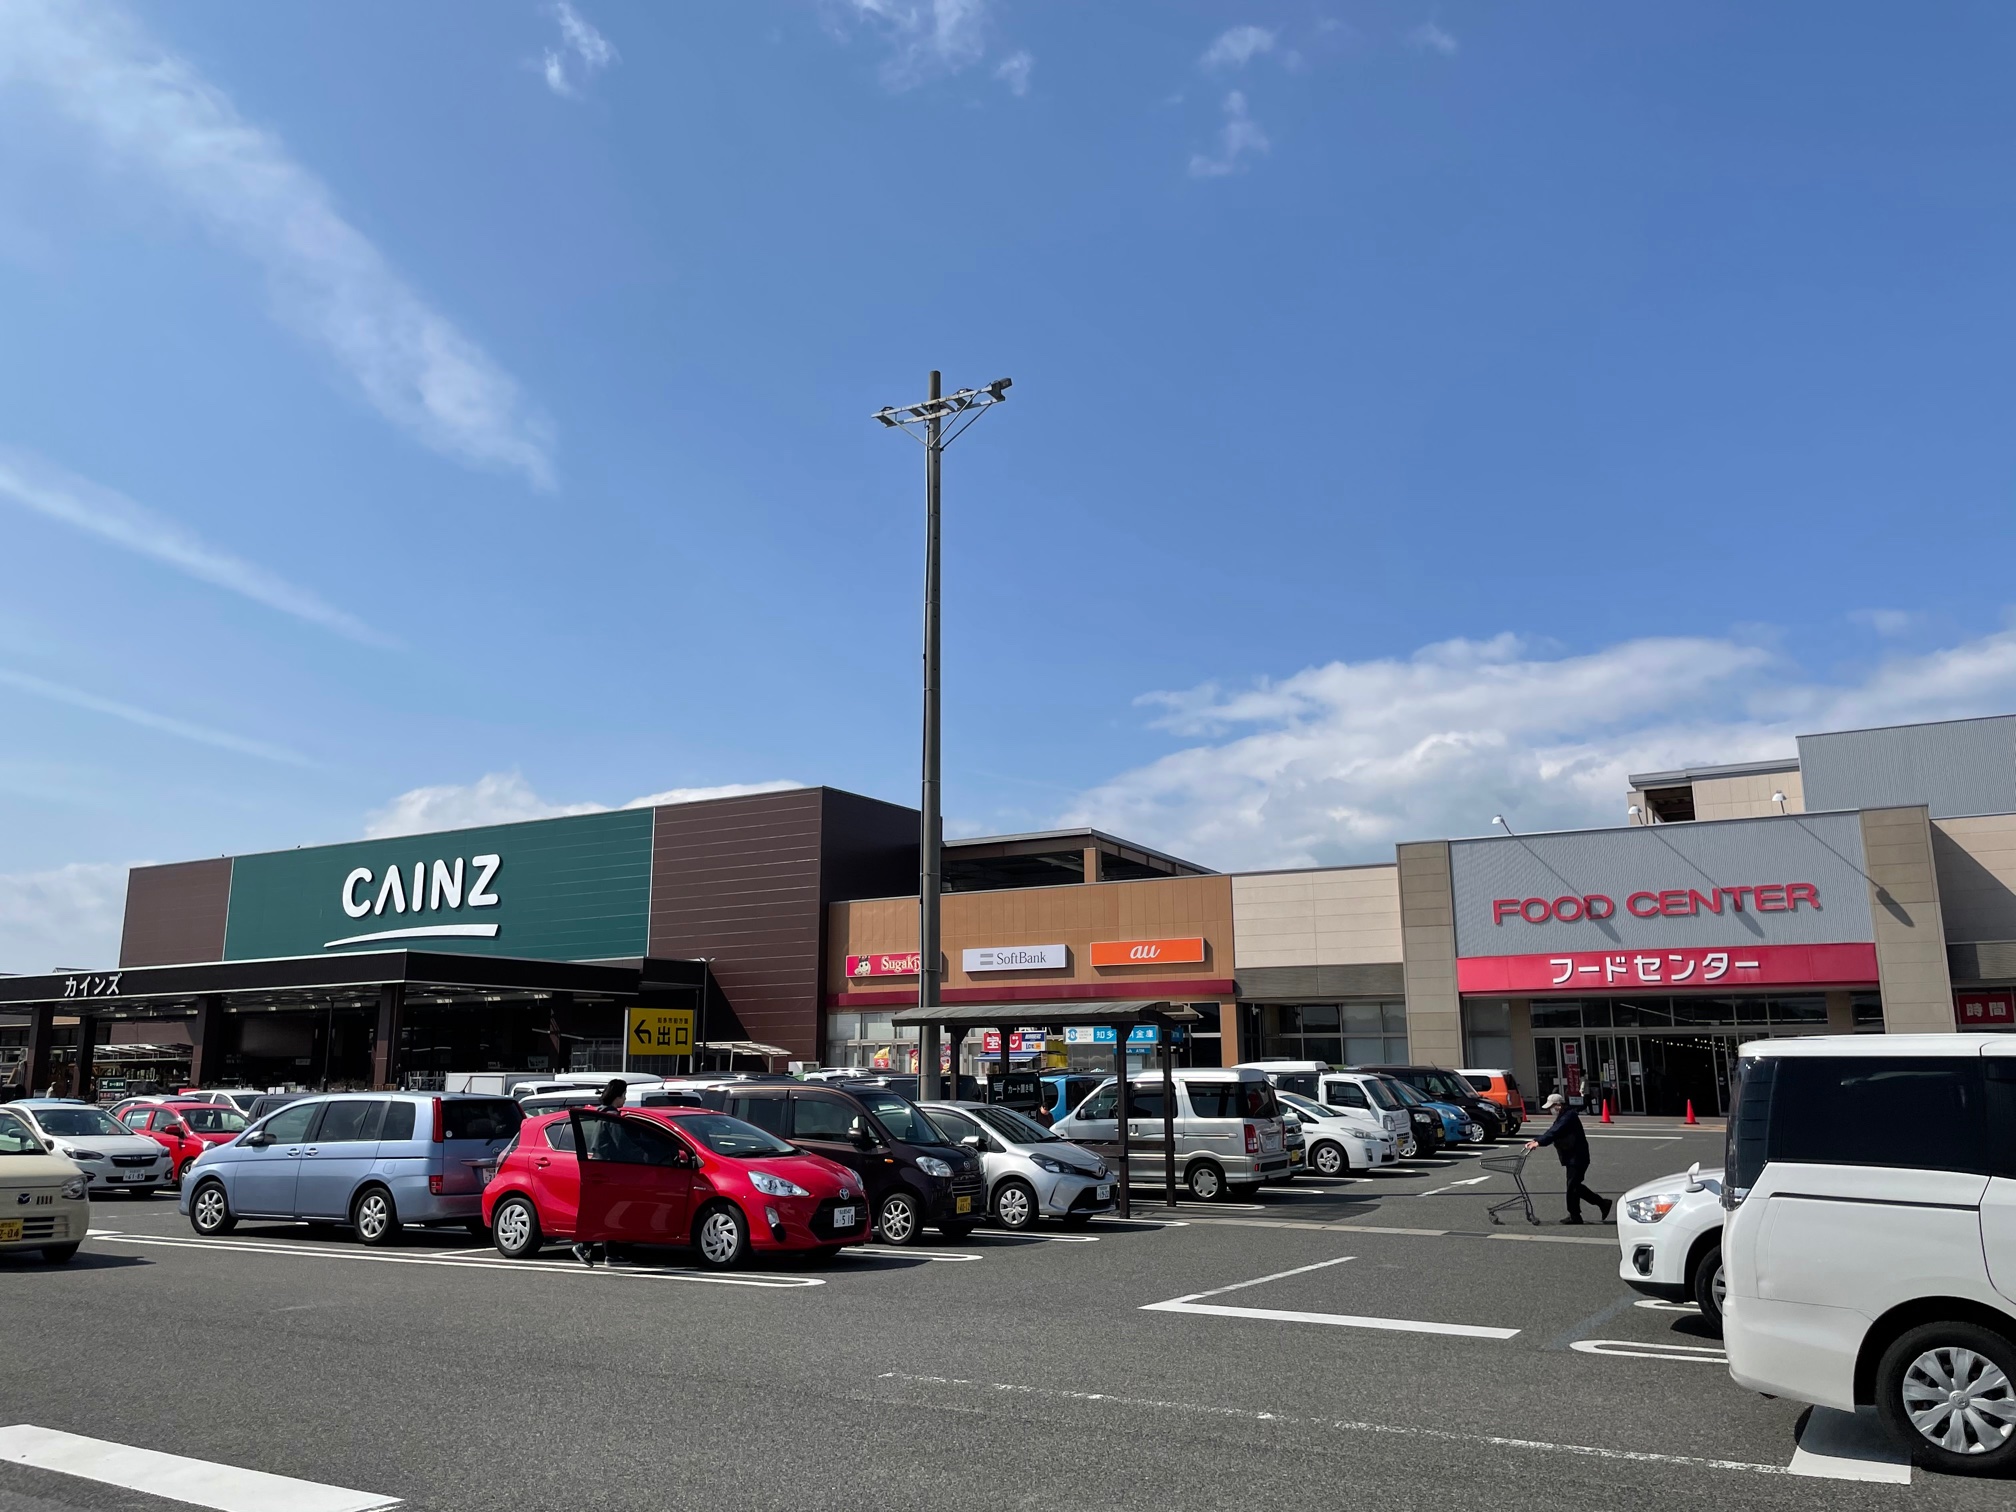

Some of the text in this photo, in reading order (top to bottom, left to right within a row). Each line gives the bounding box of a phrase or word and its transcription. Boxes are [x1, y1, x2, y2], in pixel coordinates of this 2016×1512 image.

[342, 854, 500, 918] CAINZ
[1493, 882, 1821, 925] FOOD CENTER
[996, 952, 1047, 966] SoftBank
[1130, 945, 1160, 960] au
[1549, 952, 1760, 983] フードセンター
[64, 972, 123, 997] カインズ
[1966, 1002, 2006, 1017] 時間
[657, 1026, 688, 1046] 出口
